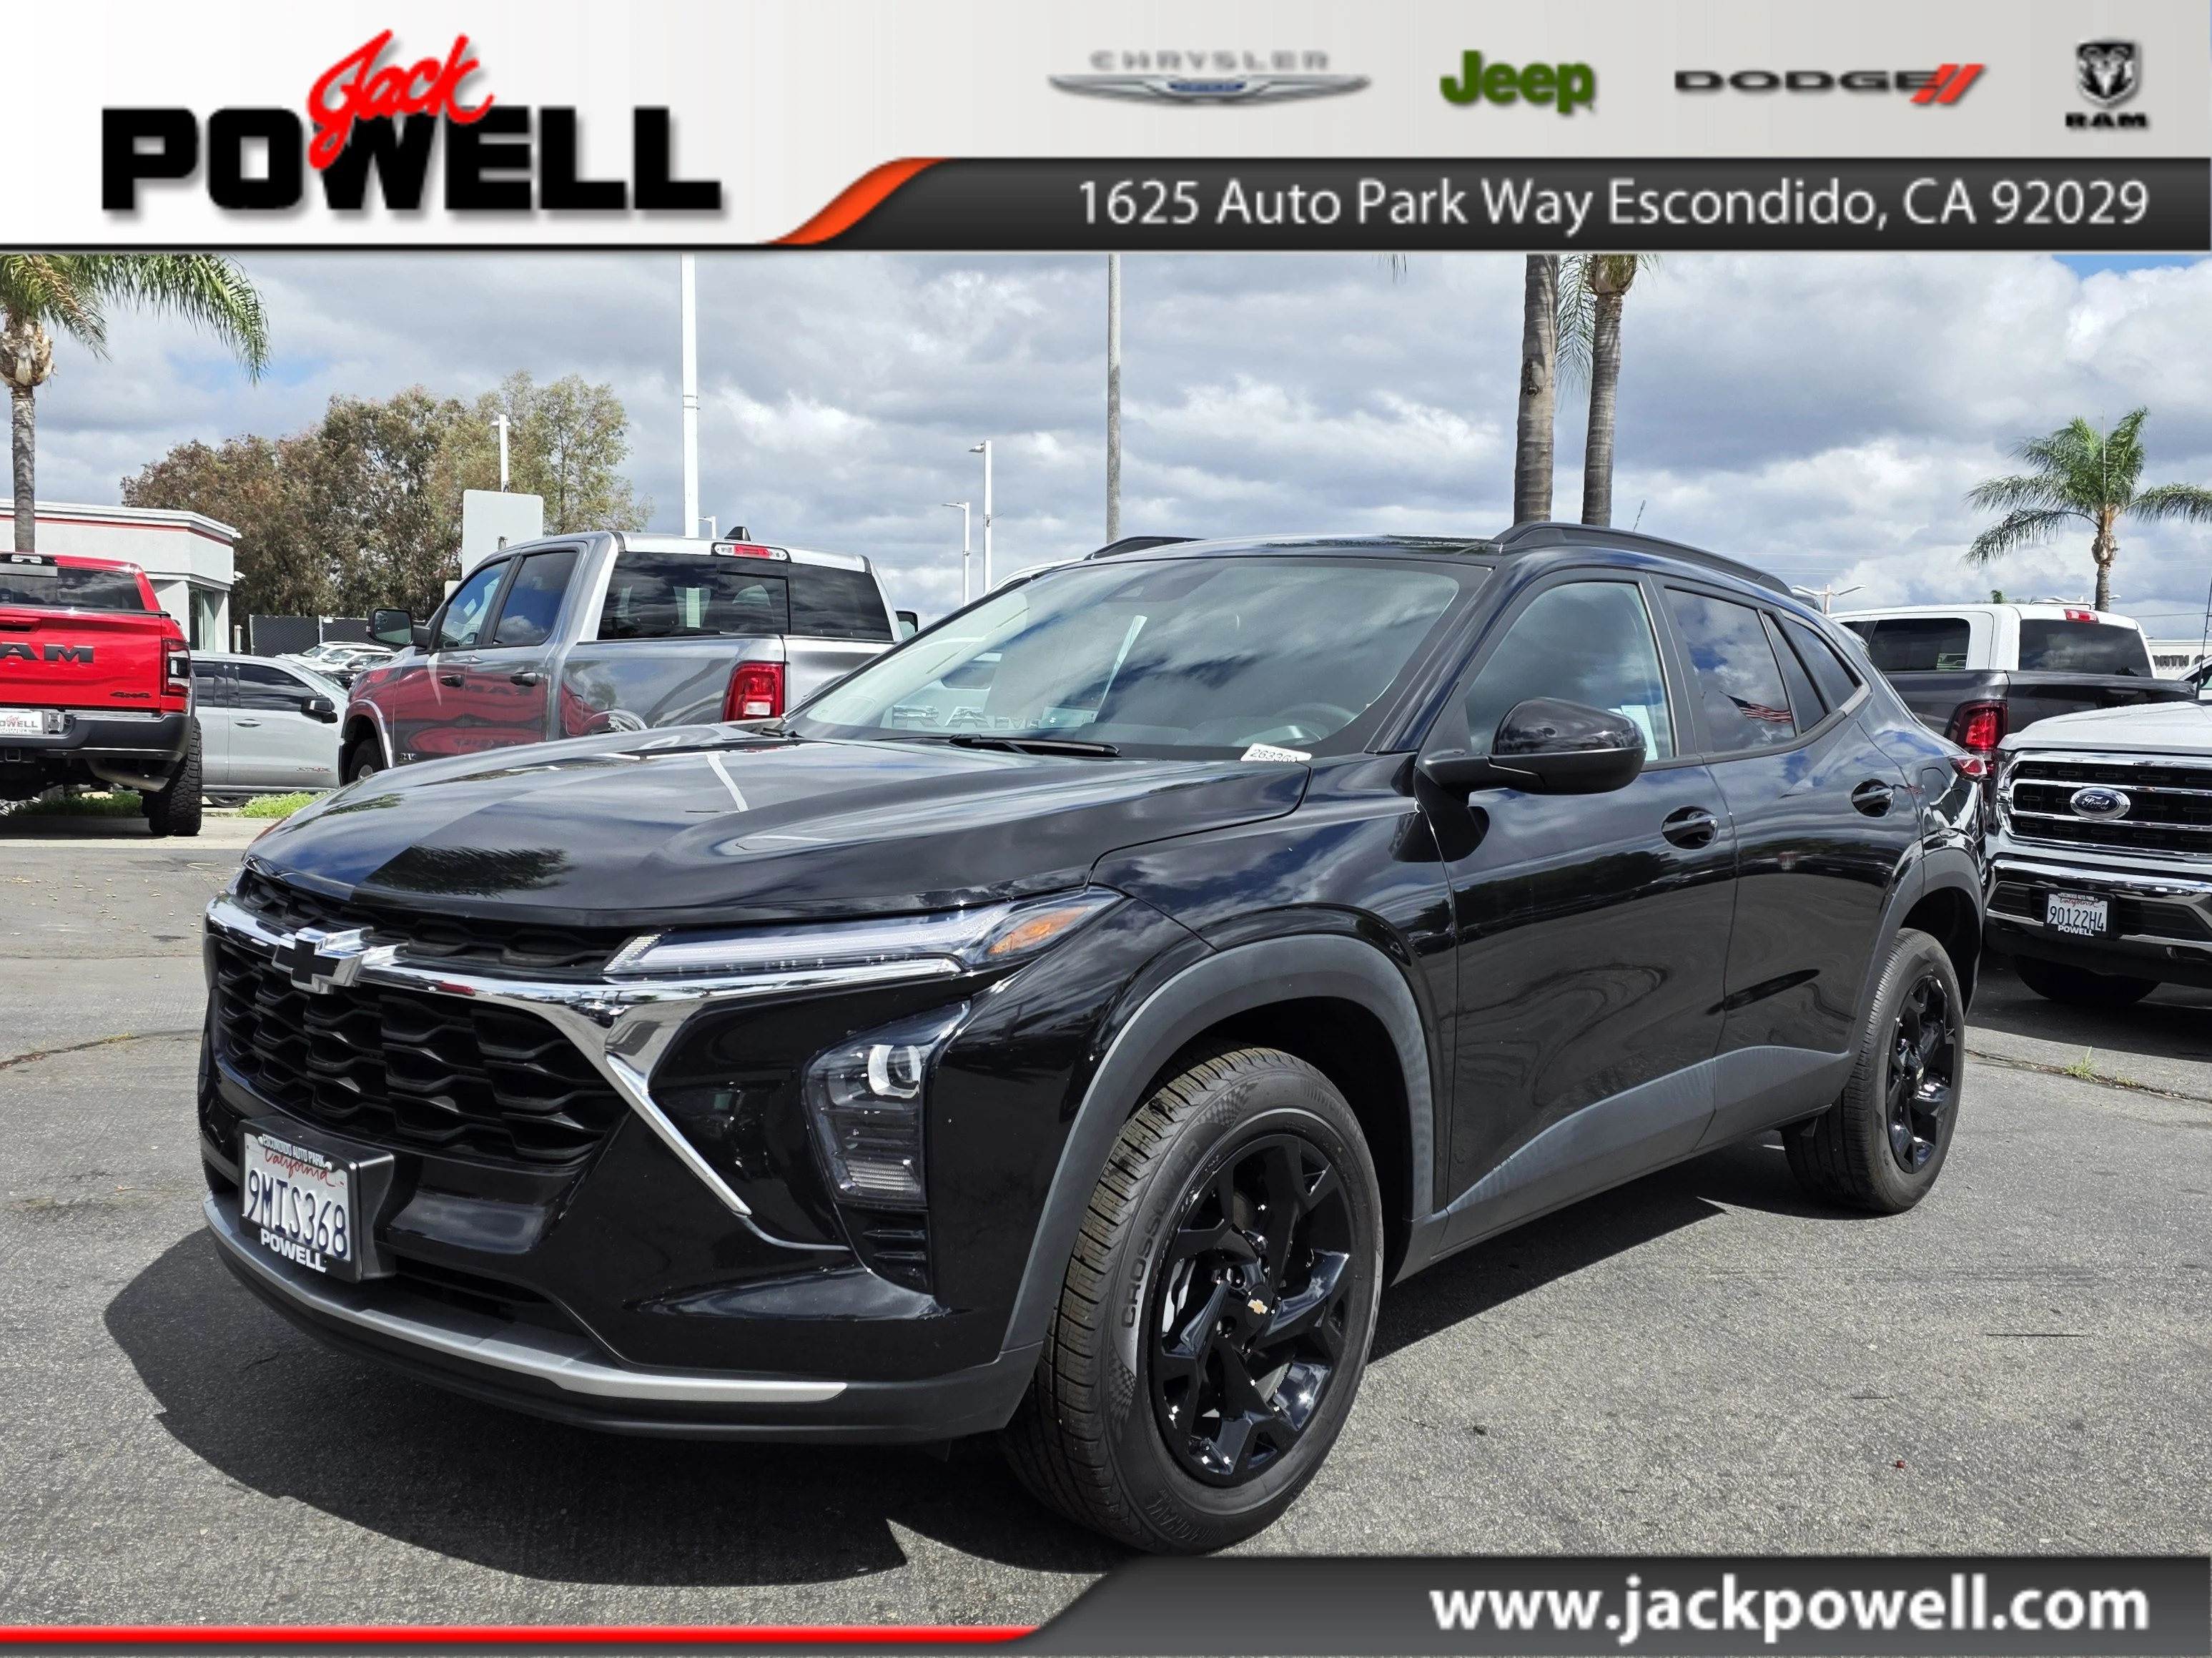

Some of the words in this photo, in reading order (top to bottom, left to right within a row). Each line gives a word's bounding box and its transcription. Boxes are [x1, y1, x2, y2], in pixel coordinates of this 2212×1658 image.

[0, 642, 94, 663] AM
[2081, 795, 2110, 808] Ford
[2049, 906, 2104, 930] 90122H4
[2058, 925, 2094, 937] POWELL
[265, 1148, 335, 1187] California
[292, 1145, 307, 1163] AUTO
[307, 1150, 325, 1168] PARK
[247, 1168, 347, 1258] 9MIS368
[261, 1228, 327, 1273] POWELL
